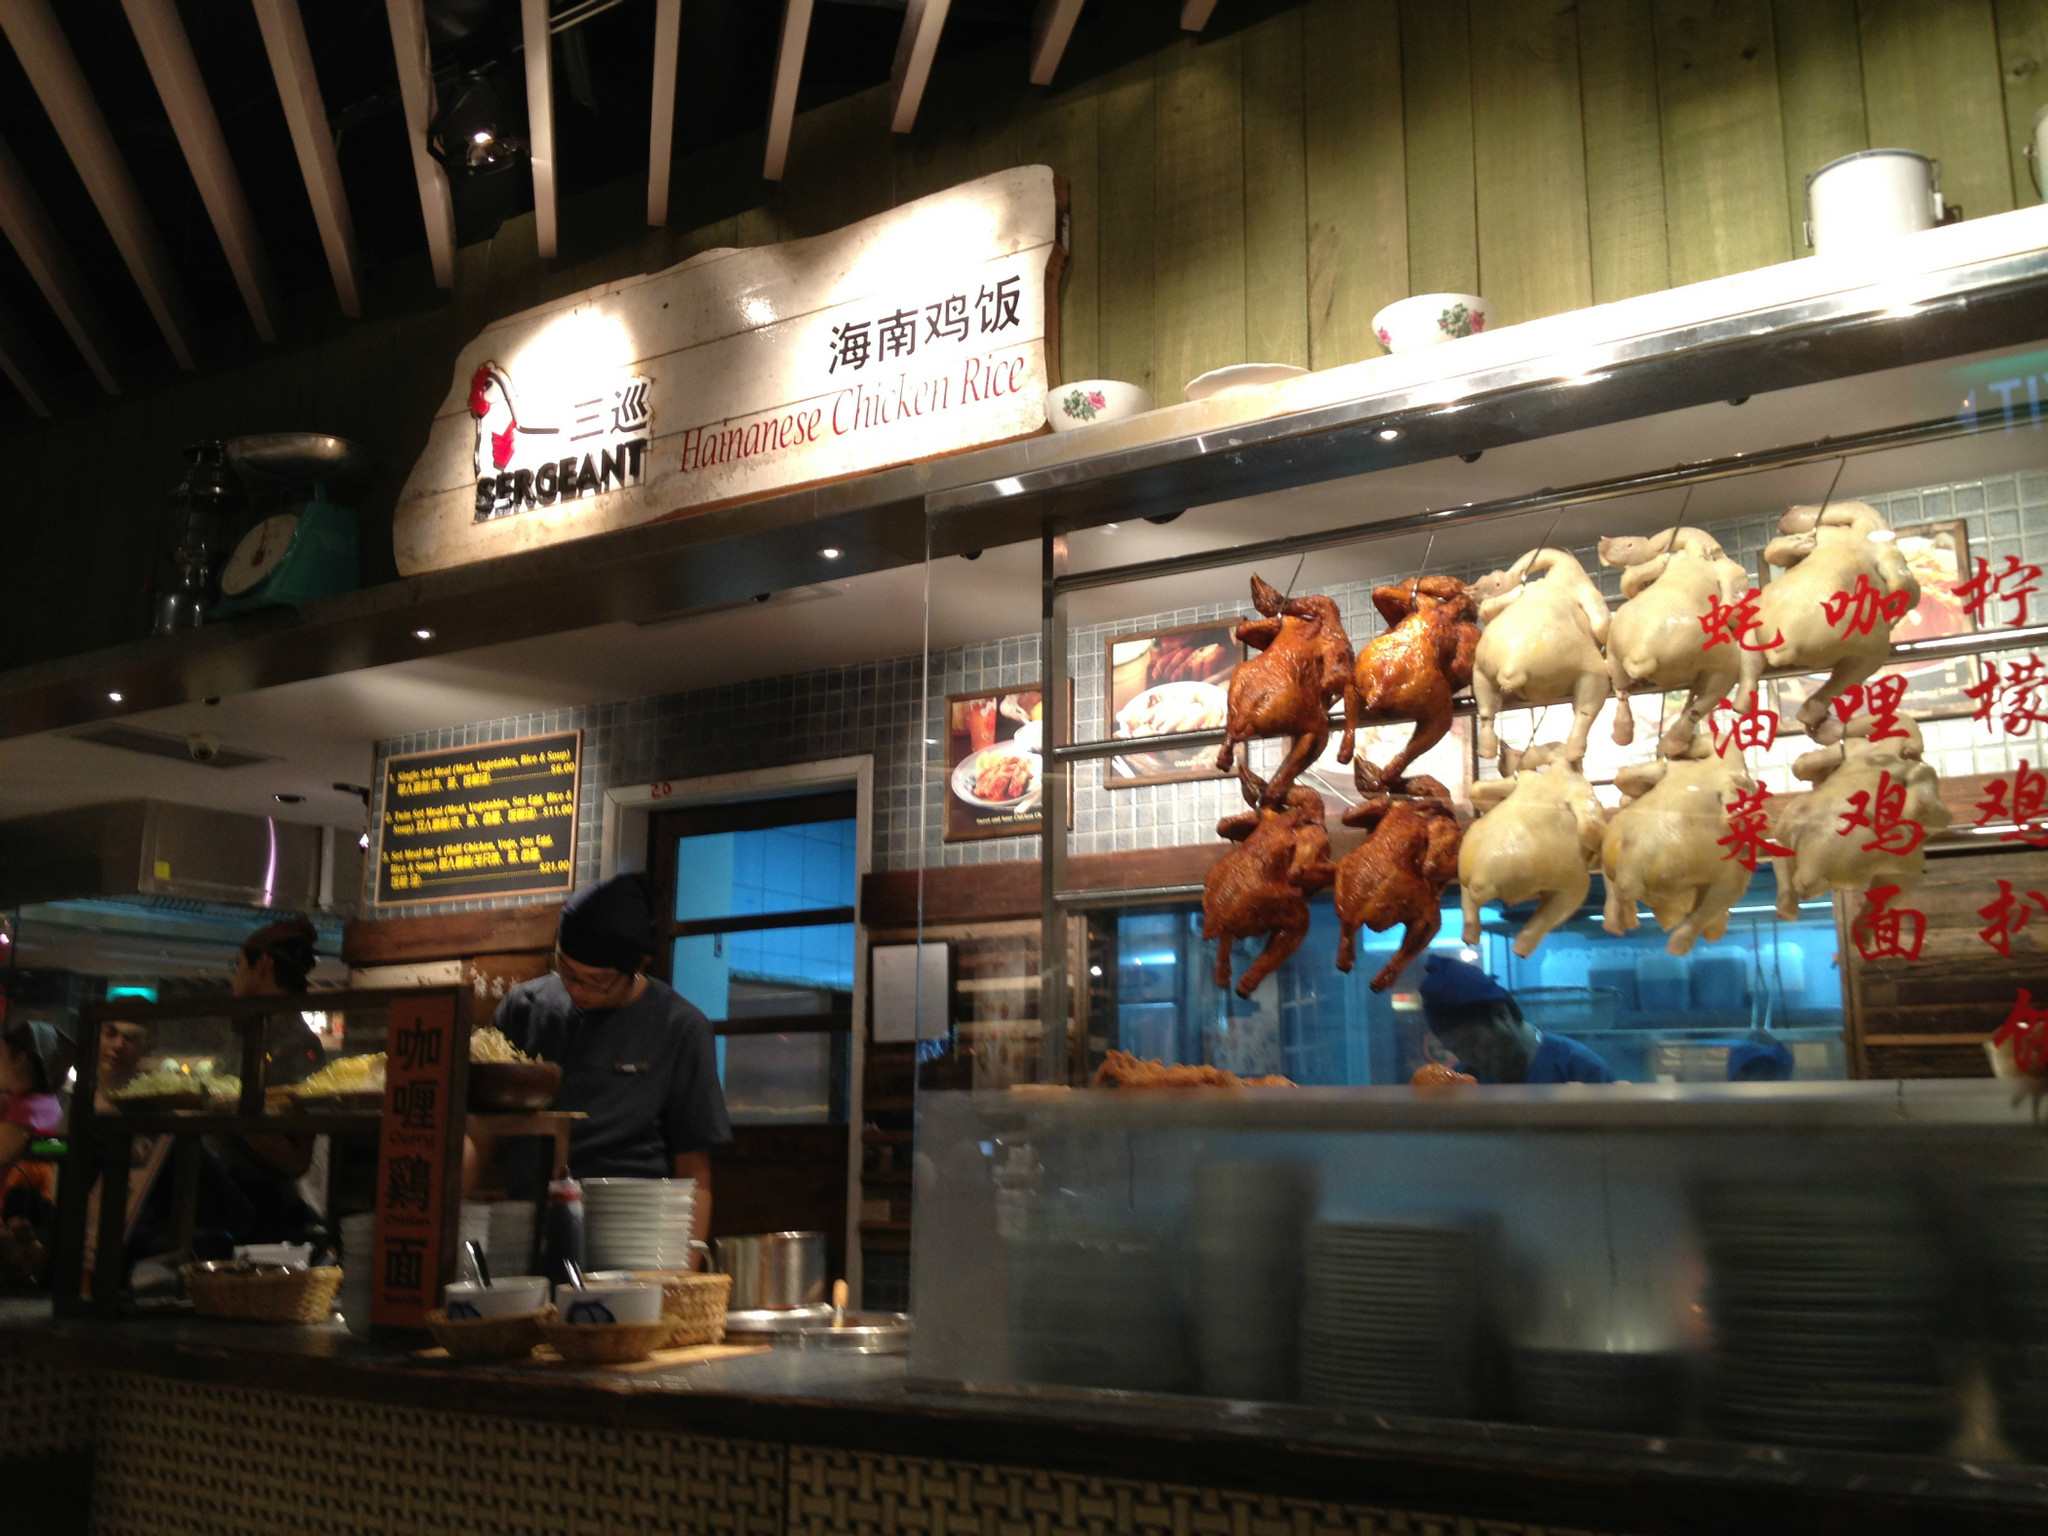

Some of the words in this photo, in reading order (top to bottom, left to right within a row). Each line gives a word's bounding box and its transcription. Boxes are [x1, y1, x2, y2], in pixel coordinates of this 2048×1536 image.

[828, 275, 1021, 375] 海南鸡饭
[570, 383, 647, 441] 三巡
[680, 407, 821, 472] Hainanese
[832, 373, 949, 435] Chicken
[961, 354, 1025, 406] Rice
[475, 438, 647, 518] SERGEANT
[520, 753, 538, 766] Rice
[539, 751, 546, 764] &
[547, 748, 571, 763] Soup)
[1698, 588, 1796, 873] 蚝油菜
[1821, 573, 1926, 962] 咖哩鸡面
[543, 803, 574, 819] $11.00
[547, 791, 565, 805] Rice
[565, 789, 573, 802] &
[436, 845, 443, 857] 4
[540, 859, 570, 875] $21.00
